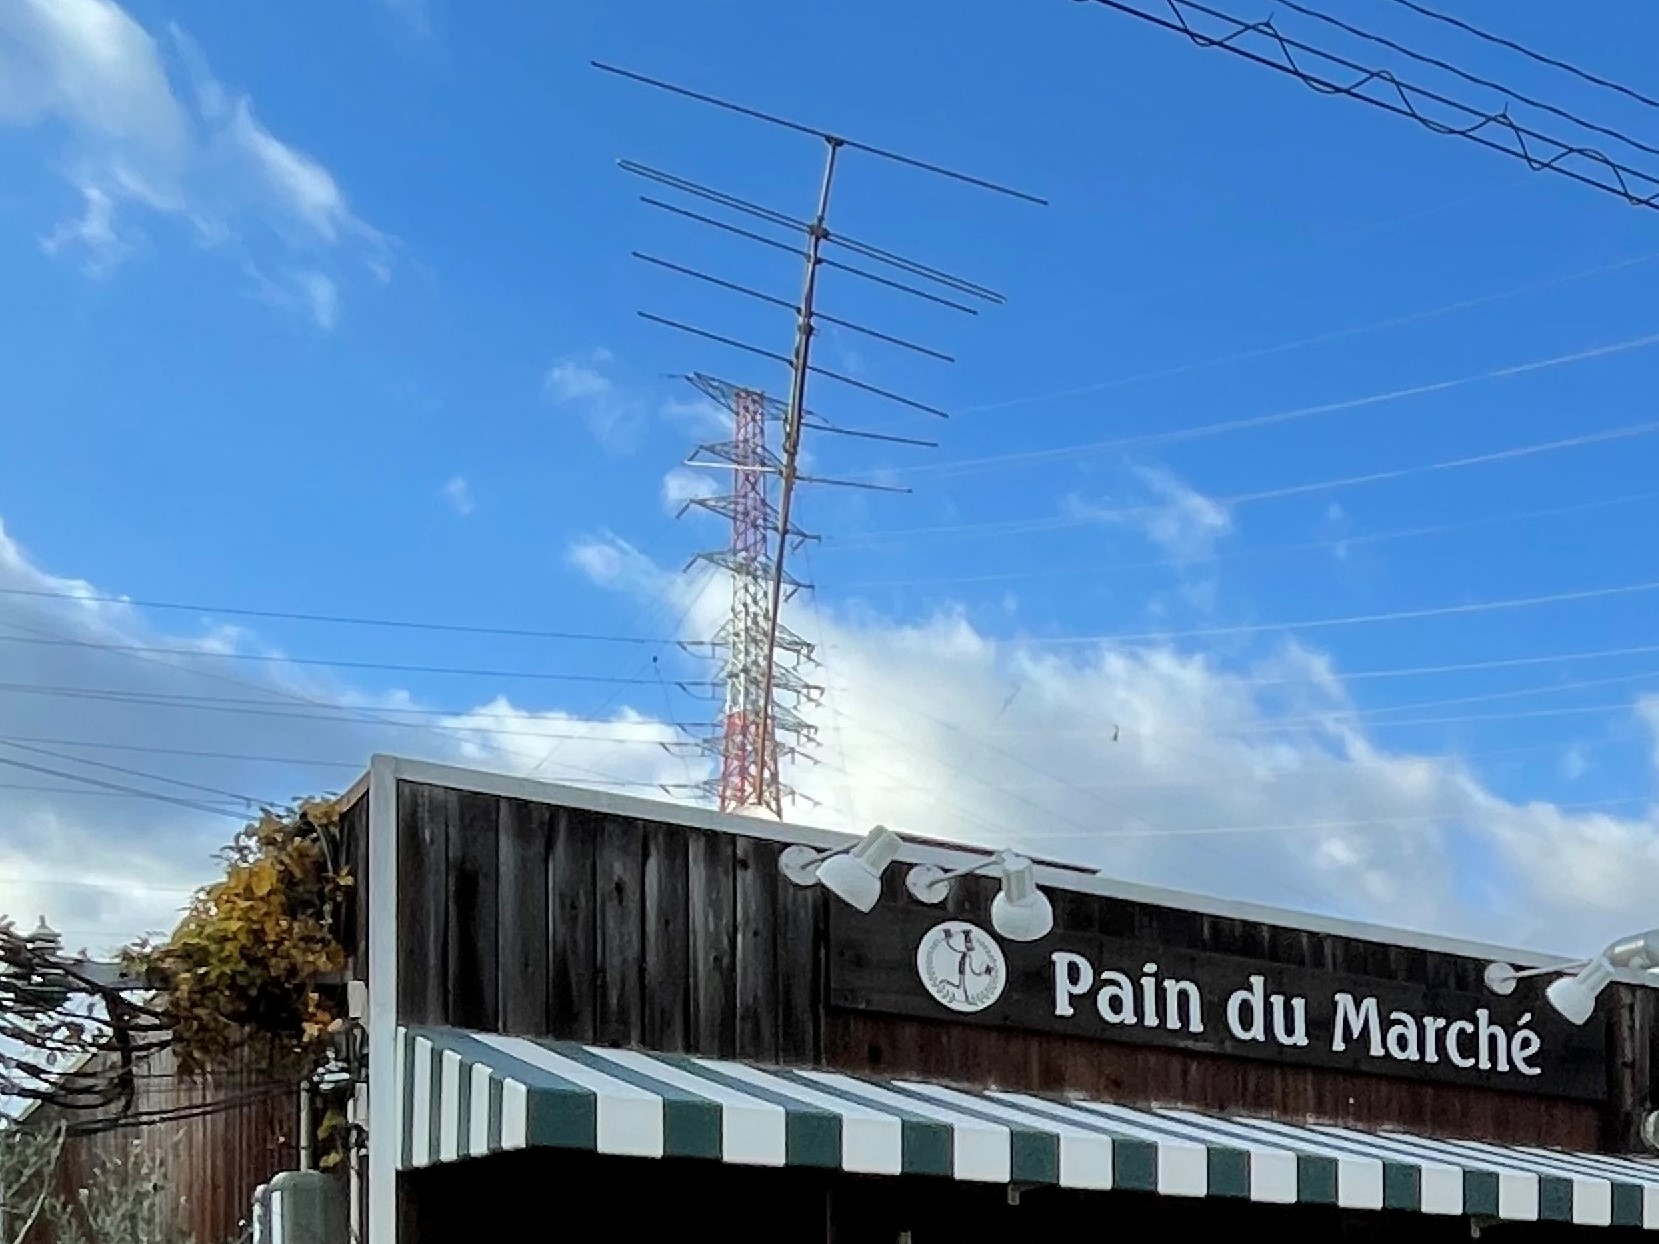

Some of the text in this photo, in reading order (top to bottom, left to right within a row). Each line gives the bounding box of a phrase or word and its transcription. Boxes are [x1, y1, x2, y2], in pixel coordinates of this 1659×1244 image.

[1050, 952, 1543, 1077] Pain du Marché
